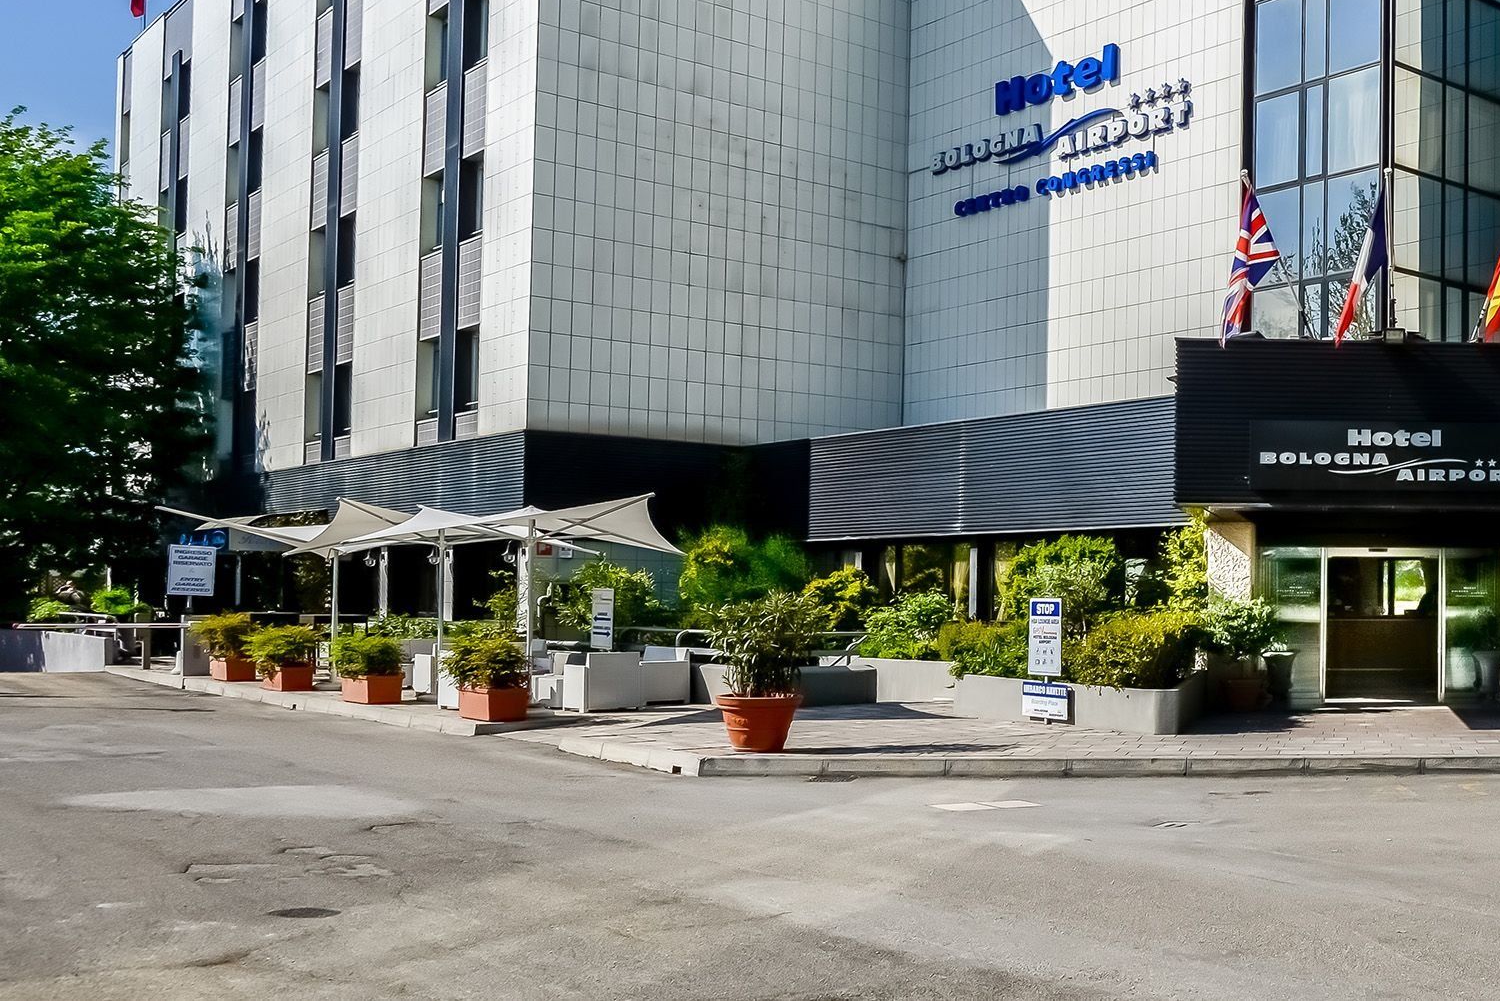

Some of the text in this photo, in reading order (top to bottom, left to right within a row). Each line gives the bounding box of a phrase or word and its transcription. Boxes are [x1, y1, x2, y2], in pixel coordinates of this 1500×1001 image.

[995, 43, 1120, 116] Hotel
[930, 100, 1193, 175] BOLOGNA AIRPORT
[954, 151, 1157, 217] CENTRO CONGRESSI
[1259, 451, 1389, 465] BOLOGNA
[1347, 429, 1442, 447] Hotel
[1036, 603, 1055, 615] STOP
